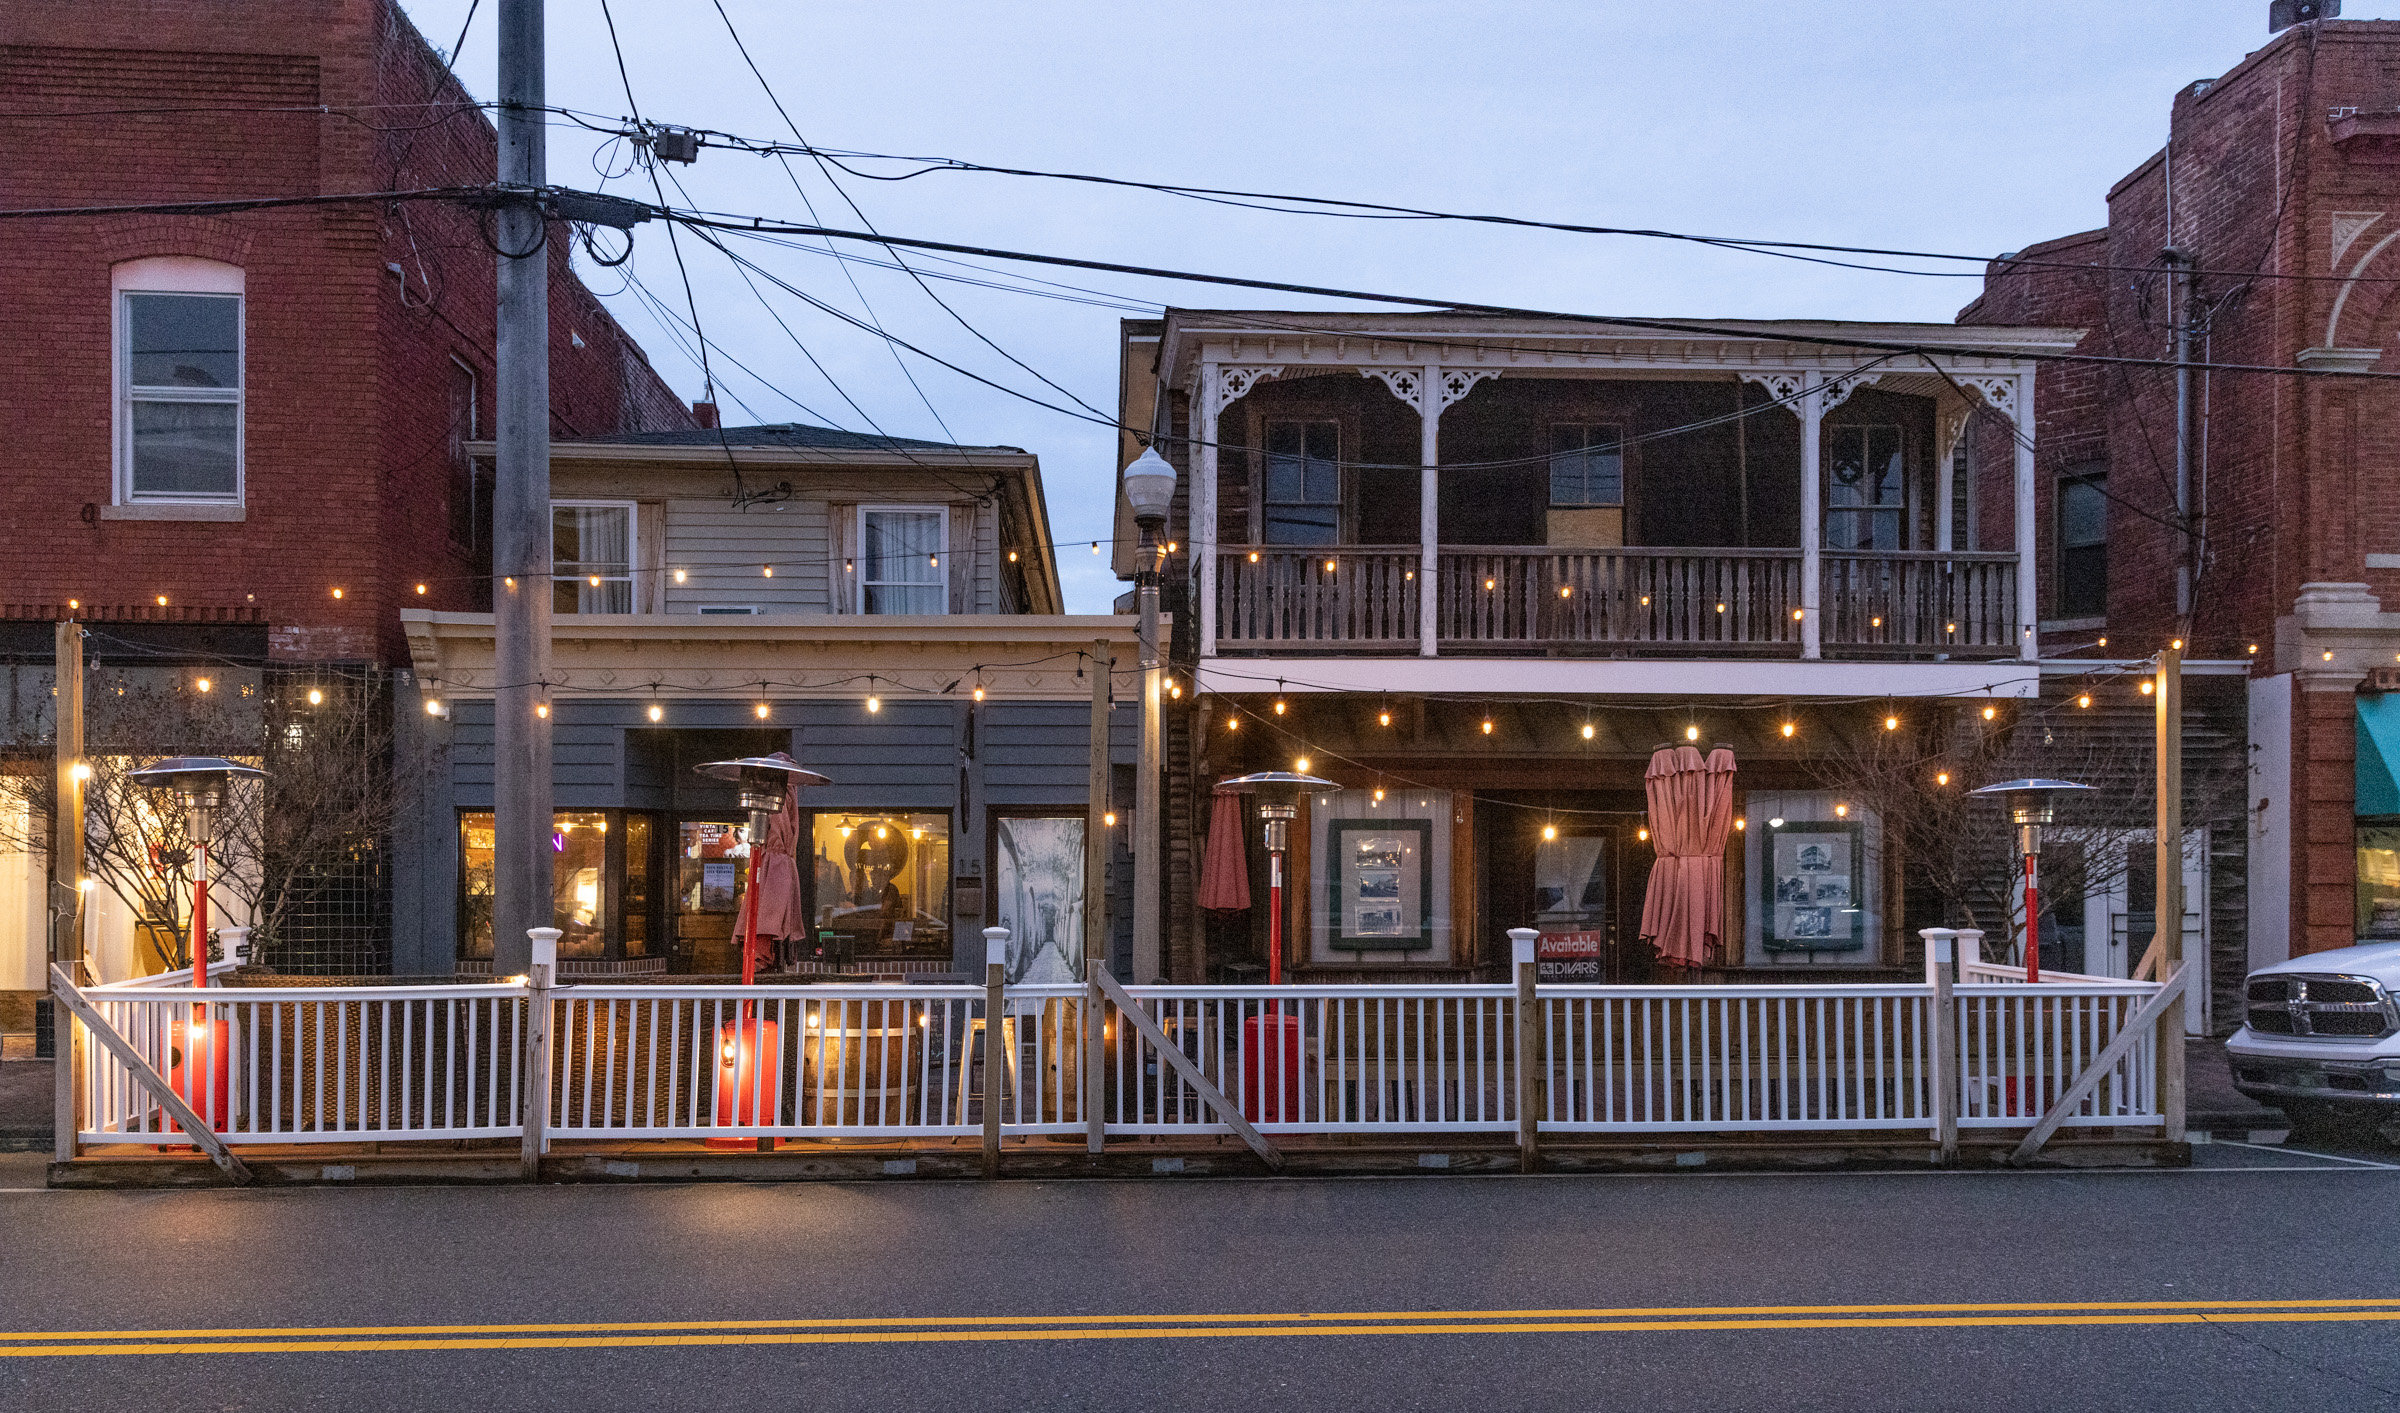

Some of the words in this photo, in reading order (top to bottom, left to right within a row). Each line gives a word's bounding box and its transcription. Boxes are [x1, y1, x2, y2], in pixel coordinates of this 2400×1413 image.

[717, 825, 729, 833] 15
[960, 859, 980, 874] 15
[1540, 935, 1598, 952] Available
[1554, 961, 1599, 974] DIVARIS
